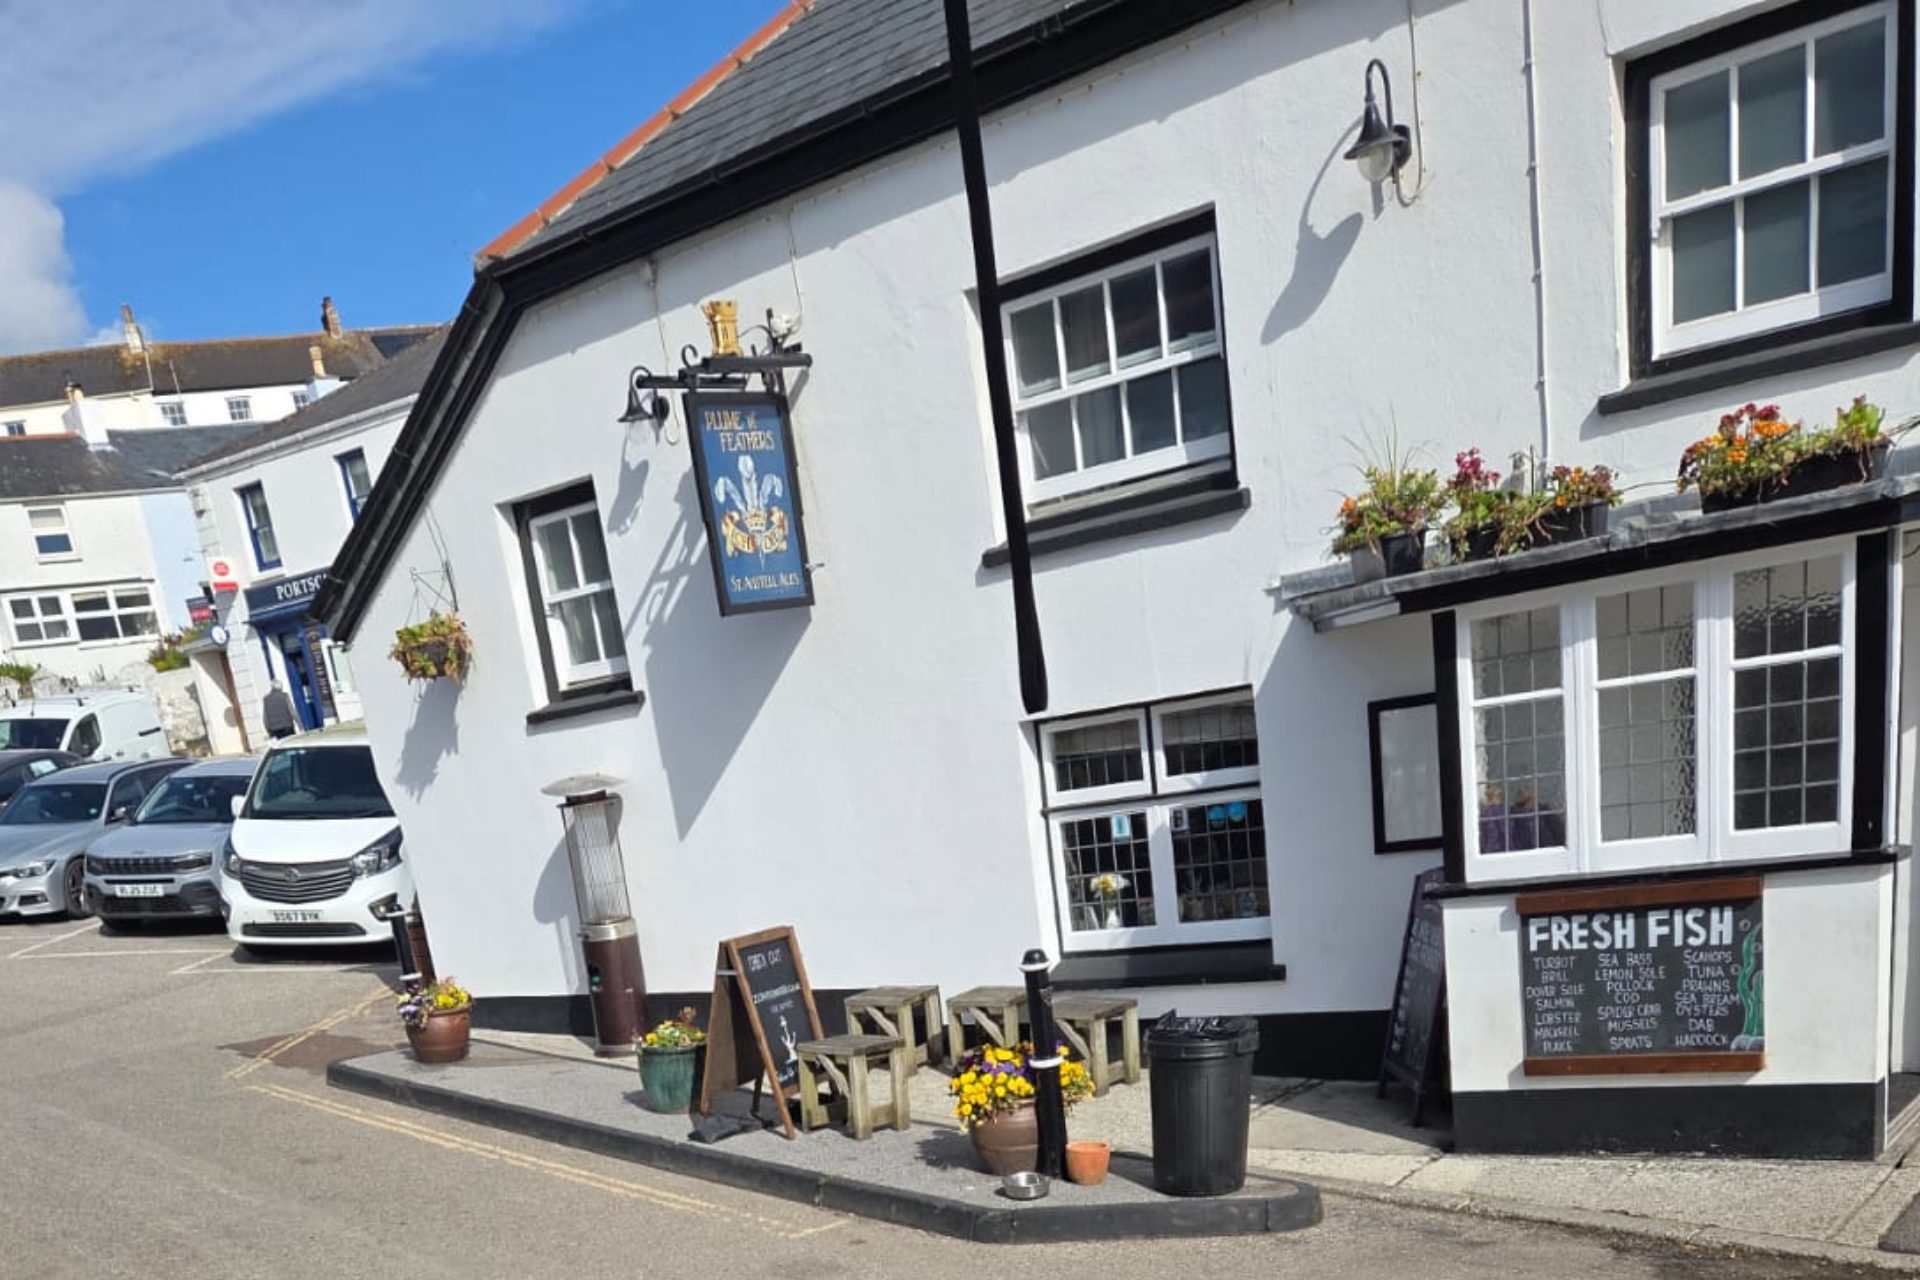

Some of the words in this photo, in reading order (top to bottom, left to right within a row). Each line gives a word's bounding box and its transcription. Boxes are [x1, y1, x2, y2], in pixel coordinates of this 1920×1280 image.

[704, 410, 743, 432] PLUME
[720, 430, 775, 453] FEATHERS
[275, 573, 326, 601] PORTSC
[1529, 913, 1635, 951] FRESH
[1647, 906, 1733, 947] FISH
[1533, 956, 1577, 970] TURBOT
[1598, 953, 1619, 967] SEA
[1626, 952, 1653, 967] BASS
[1595, 968, 1634, 981] LEMON
[1639, 965, 1667, 980] SOLE
[1688, 964, 1725, 978] TUNA
[1526, 986, 1556, 998] DOVER
[1561, 984, 1585, 995] SOLE
[1607, 980, 1655, 993] POLLOCK
[1682, 979, 1731, 992] PRAWNS
[1535, 998, 1575, 1011] SALMON
[1614, 992, 1640, 1004] COD
[1674, 991, 1696, 1004] SEA
[1702, 993, 1741, 1005] BREAM
[1597, 1006, 1634, 1020] SPIDER
[1637, 1003, 1662, 1017] CRAB
[1675, 1002, 1729, 1017] OYSTERS
[1535, 1012, 1582, 1025] LOBSTER
[1608, 1017, 1658, 1032] MUSSELS
[1688, 1018, 1714, 1032] DAB
[1609, 1035, 1653, 1050] SPRATS
[1675, 1034, 1728, 1047] HADDOCK
